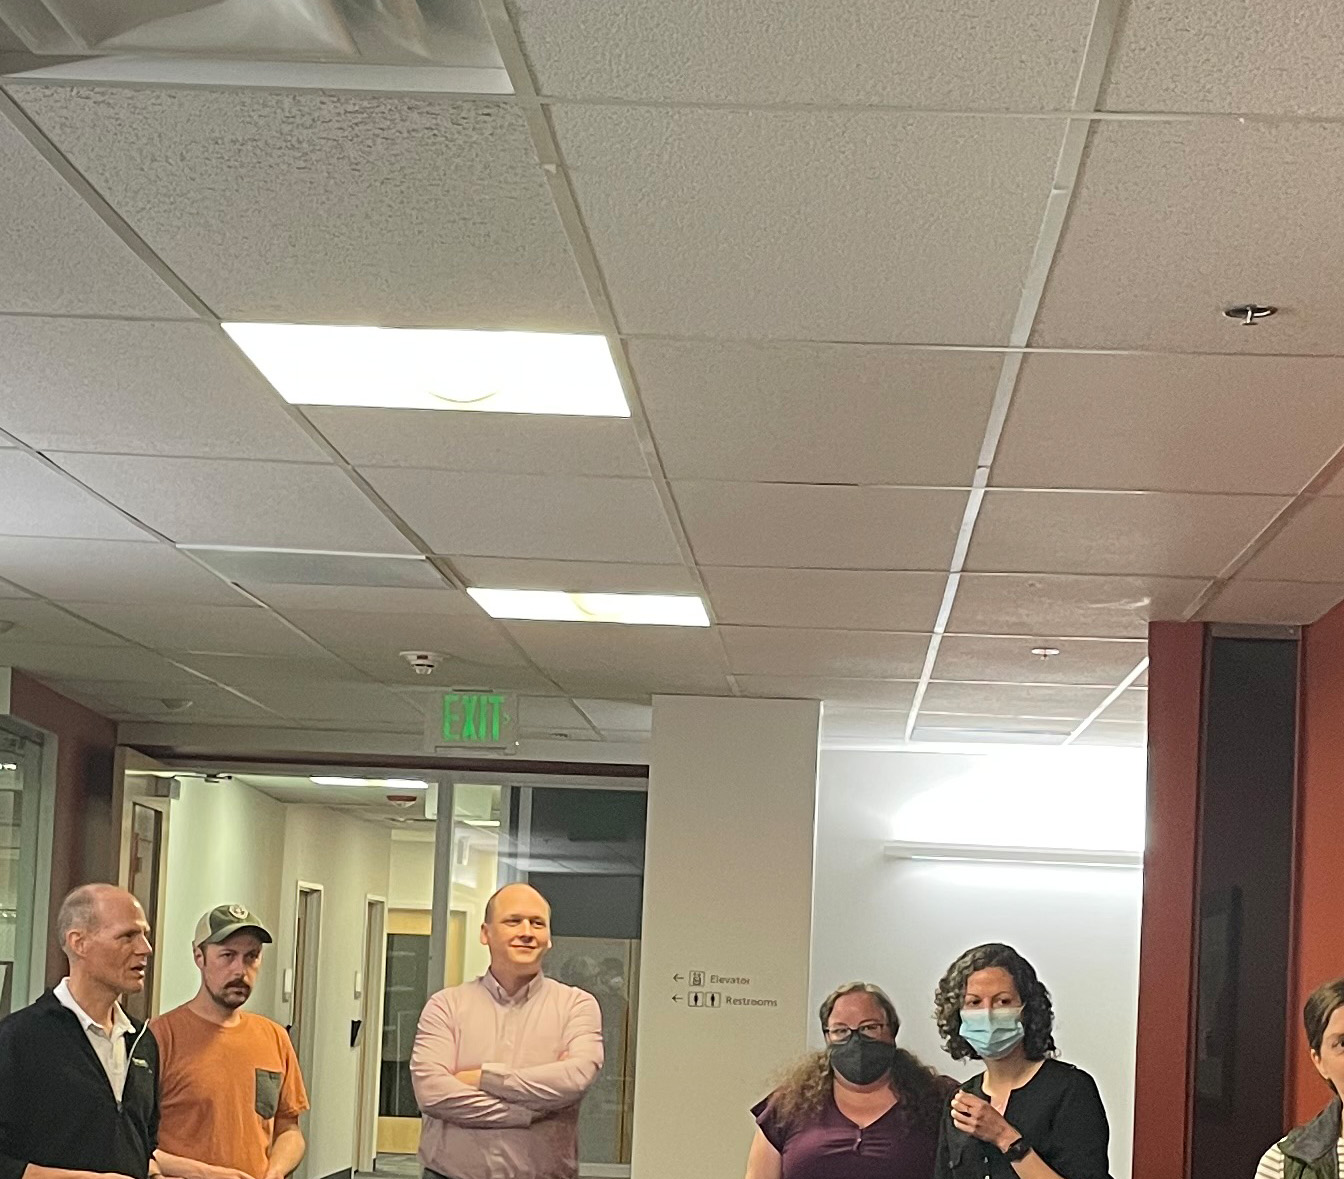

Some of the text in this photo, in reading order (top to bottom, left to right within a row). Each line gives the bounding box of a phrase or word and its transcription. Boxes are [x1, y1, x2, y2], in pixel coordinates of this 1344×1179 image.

[443, 694, 505, 742] EXIT
[710, 974, 751, 985] Elevator
[725, 995, 778, 1007] Restrooms
